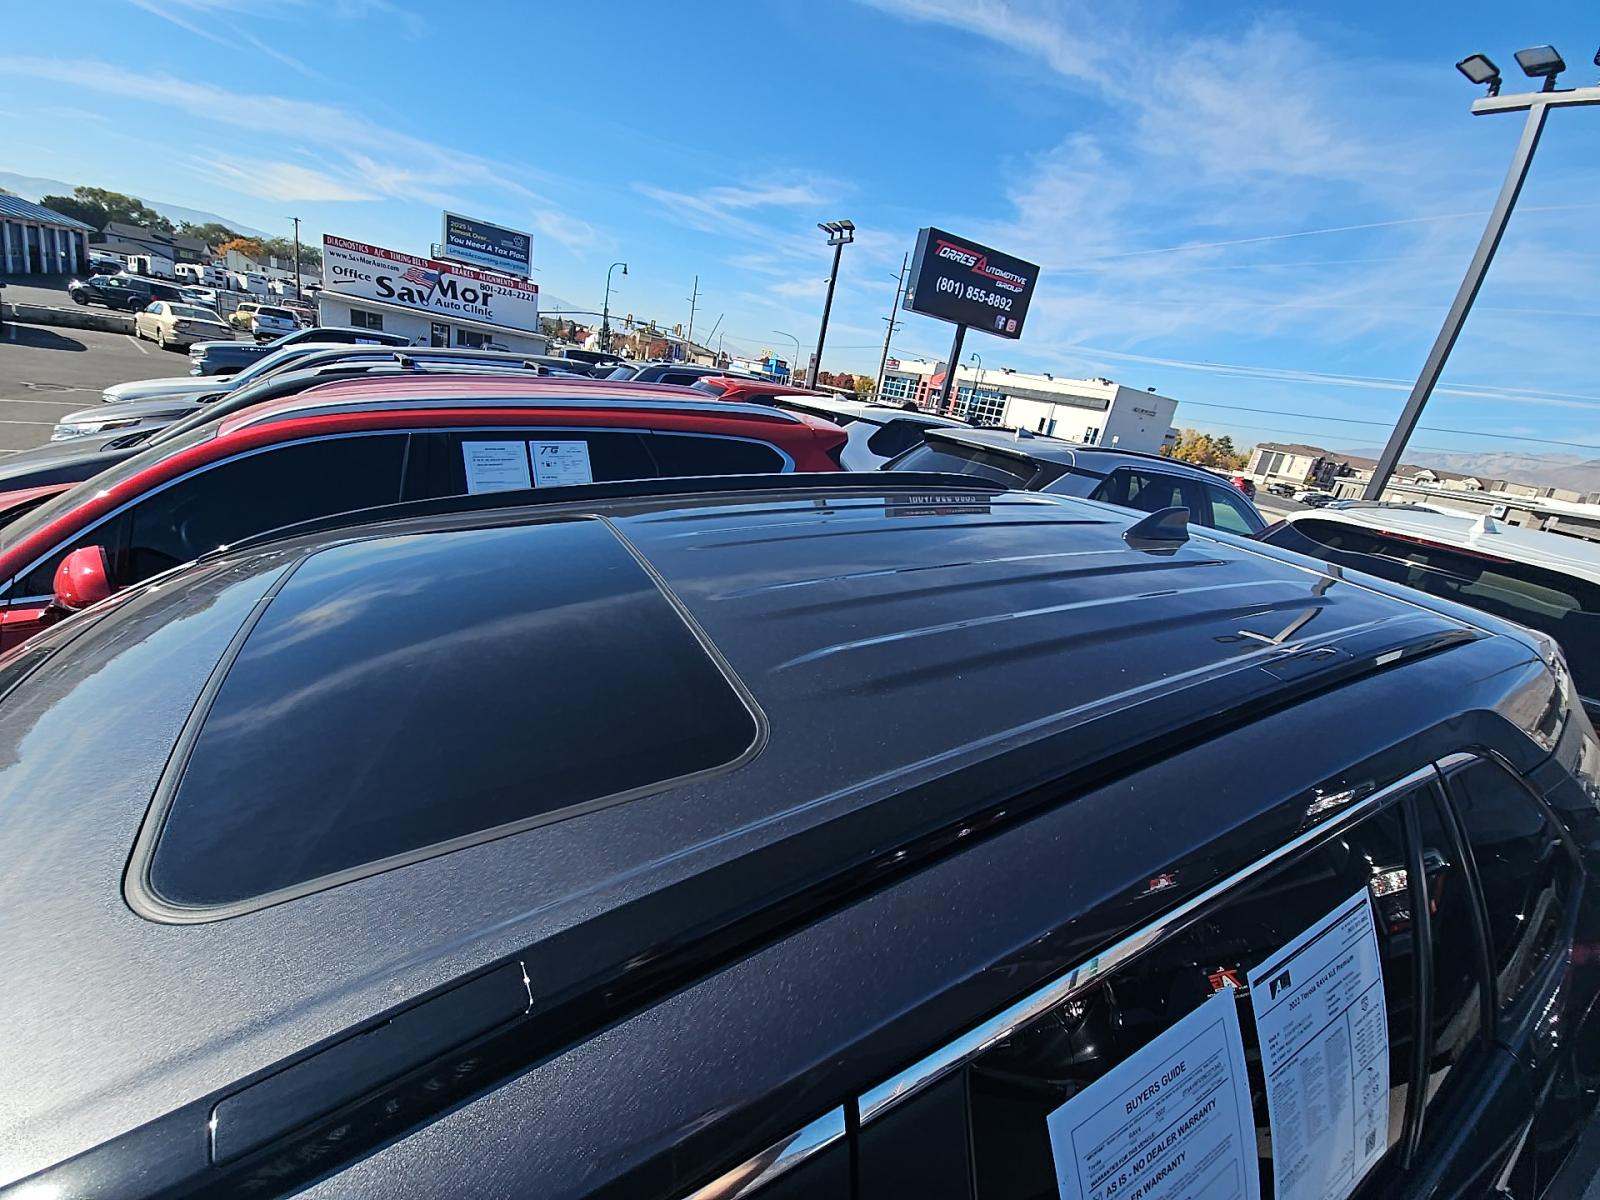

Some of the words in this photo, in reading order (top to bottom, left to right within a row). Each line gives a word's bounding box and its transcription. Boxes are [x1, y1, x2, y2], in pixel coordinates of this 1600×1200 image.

[450, 234, 464, 244] You
[466, 240, 486, 250] Need
[486, 244, 492, 252] A
[494, 246, 508, 256] Tax
[327, 236, 369, 254] DIAGNOSTICS
[374, 248, 385, 258] A/C
[479, 274, 514, 288] ALIGNMENTS
[332, 266, 371, 282] Office
[935, 239, 979, 267] TORRES
[971, 255, 1028, 286] AUTOMOTIVE
[480, 283, 534, 302] 801-224-2221
[936, 276, 964, 299] (801)
[966, 286, 1013, 311] 855-8892
[995, 280, 1023, 293] GROUP
[435, 298, 460, 310] Auto
[463, 304, 493, 317] Clinic
[1300, 985, 1317, 1000] Toyota
[1125, 1081, 1160, 1115] BUYERS
[1161, 1061, 1187, 1087] GUIDE
[1106, 1182, 1118, 1198] AS
[1118, 1173, 1128, 1187] IS
[1132, 1158, 1146, 1176] NO
[1146, 1132, 1178, 1163] DEALER
[1178, 1097, 1217, 1138] WARRANTY
[1142, 1150, 1186, 1194] WARRANTY
